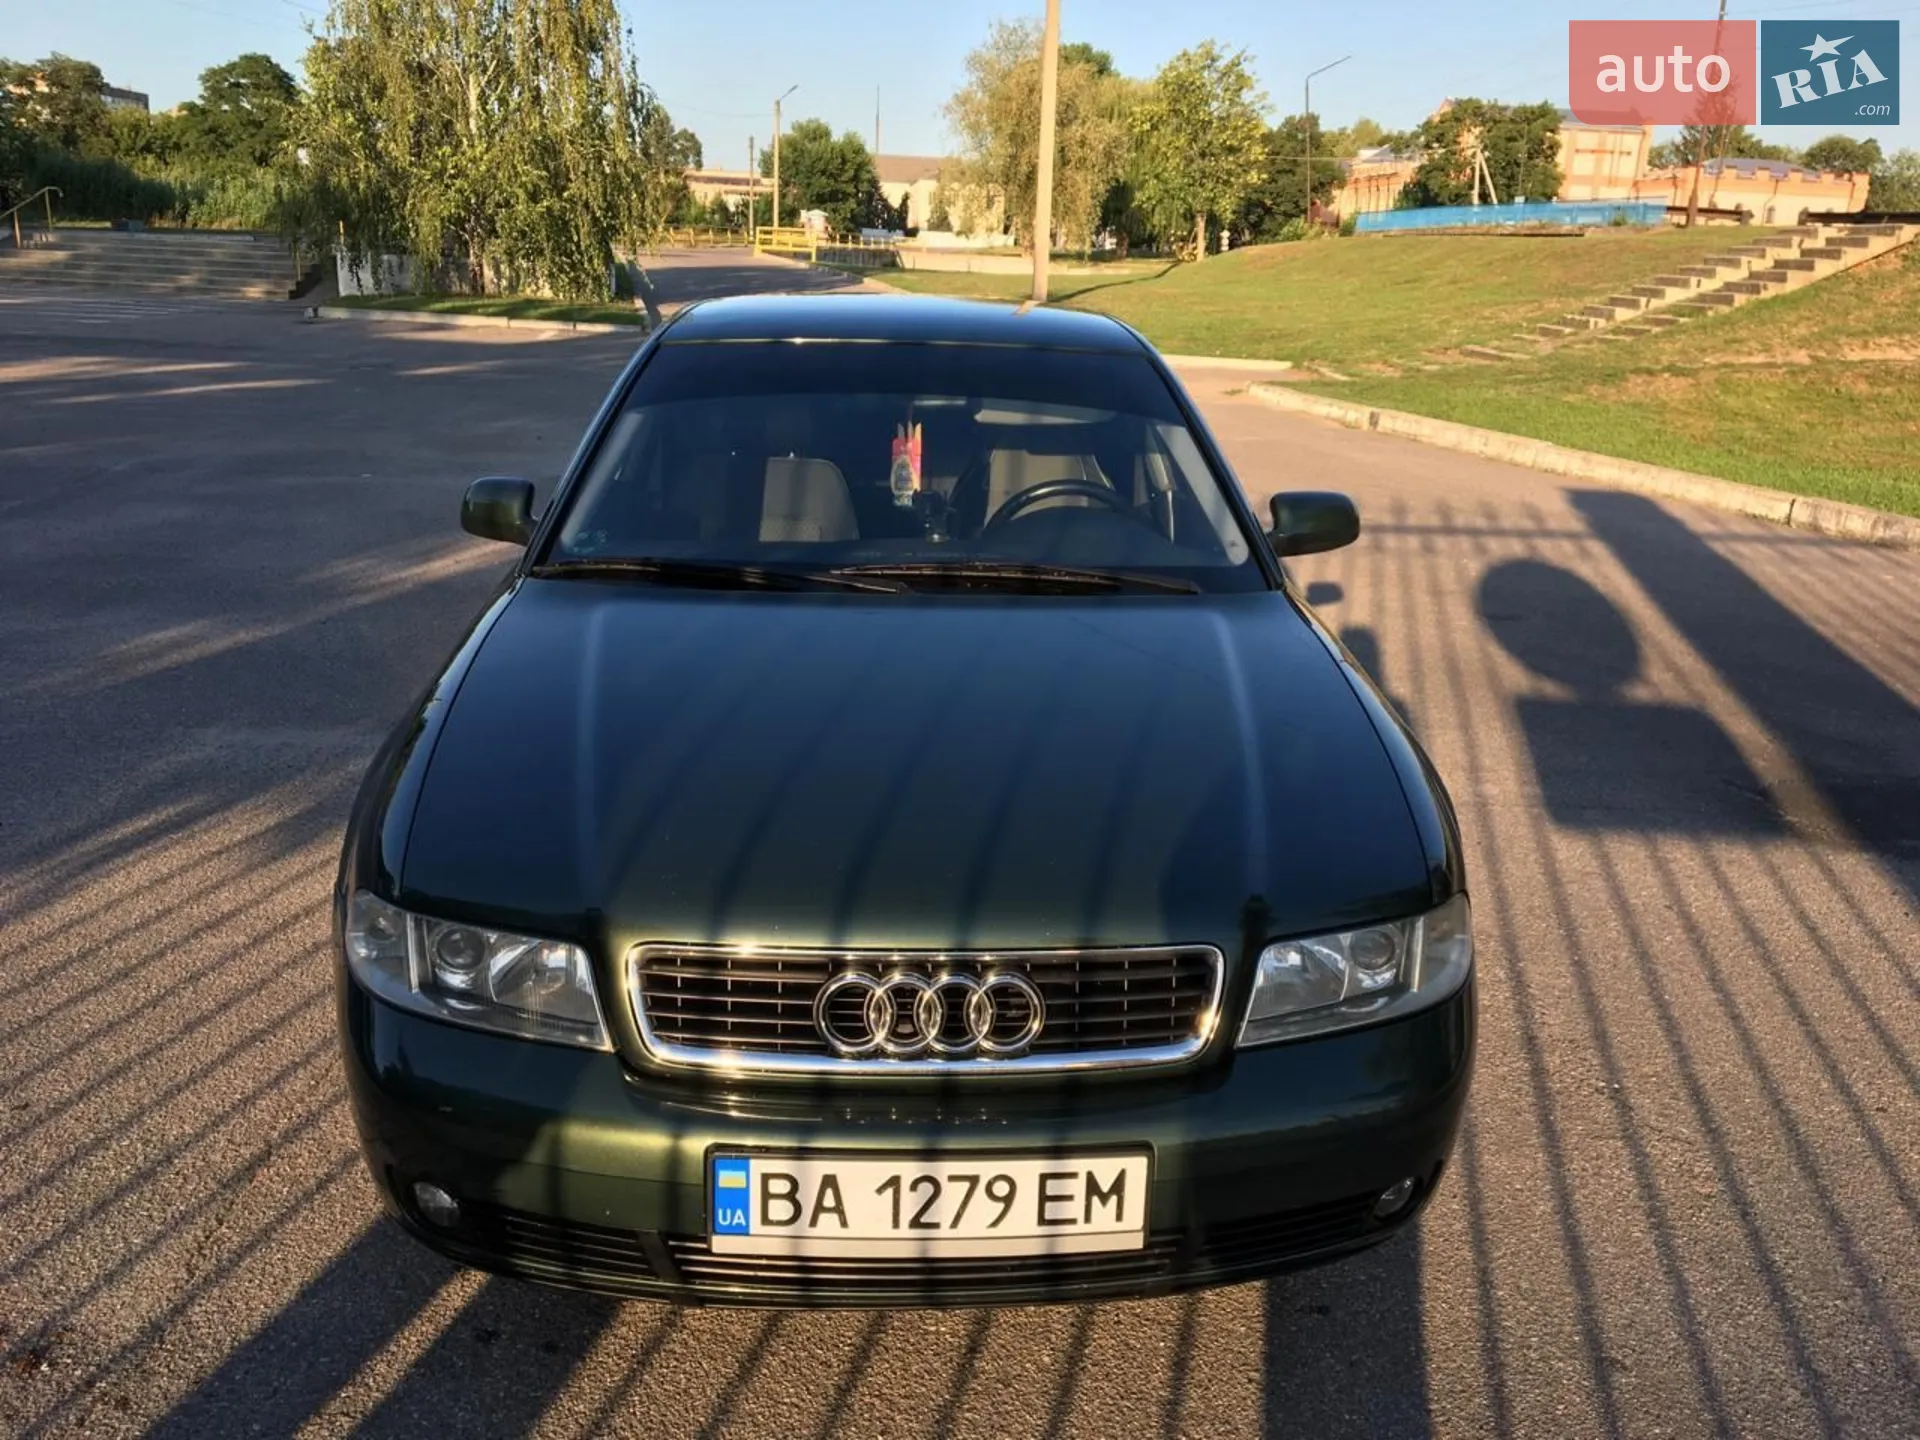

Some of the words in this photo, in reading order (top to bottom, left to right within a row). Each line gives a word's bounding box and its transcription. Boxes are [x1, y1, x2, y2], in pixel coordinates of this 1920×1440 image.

[718, 1208, 746, 1226] UA
[760, 1172, 849, 1229] BA
[875, 1174, 1018, 1230] 1279
[1036, 1167, 1128, 1227] EM
